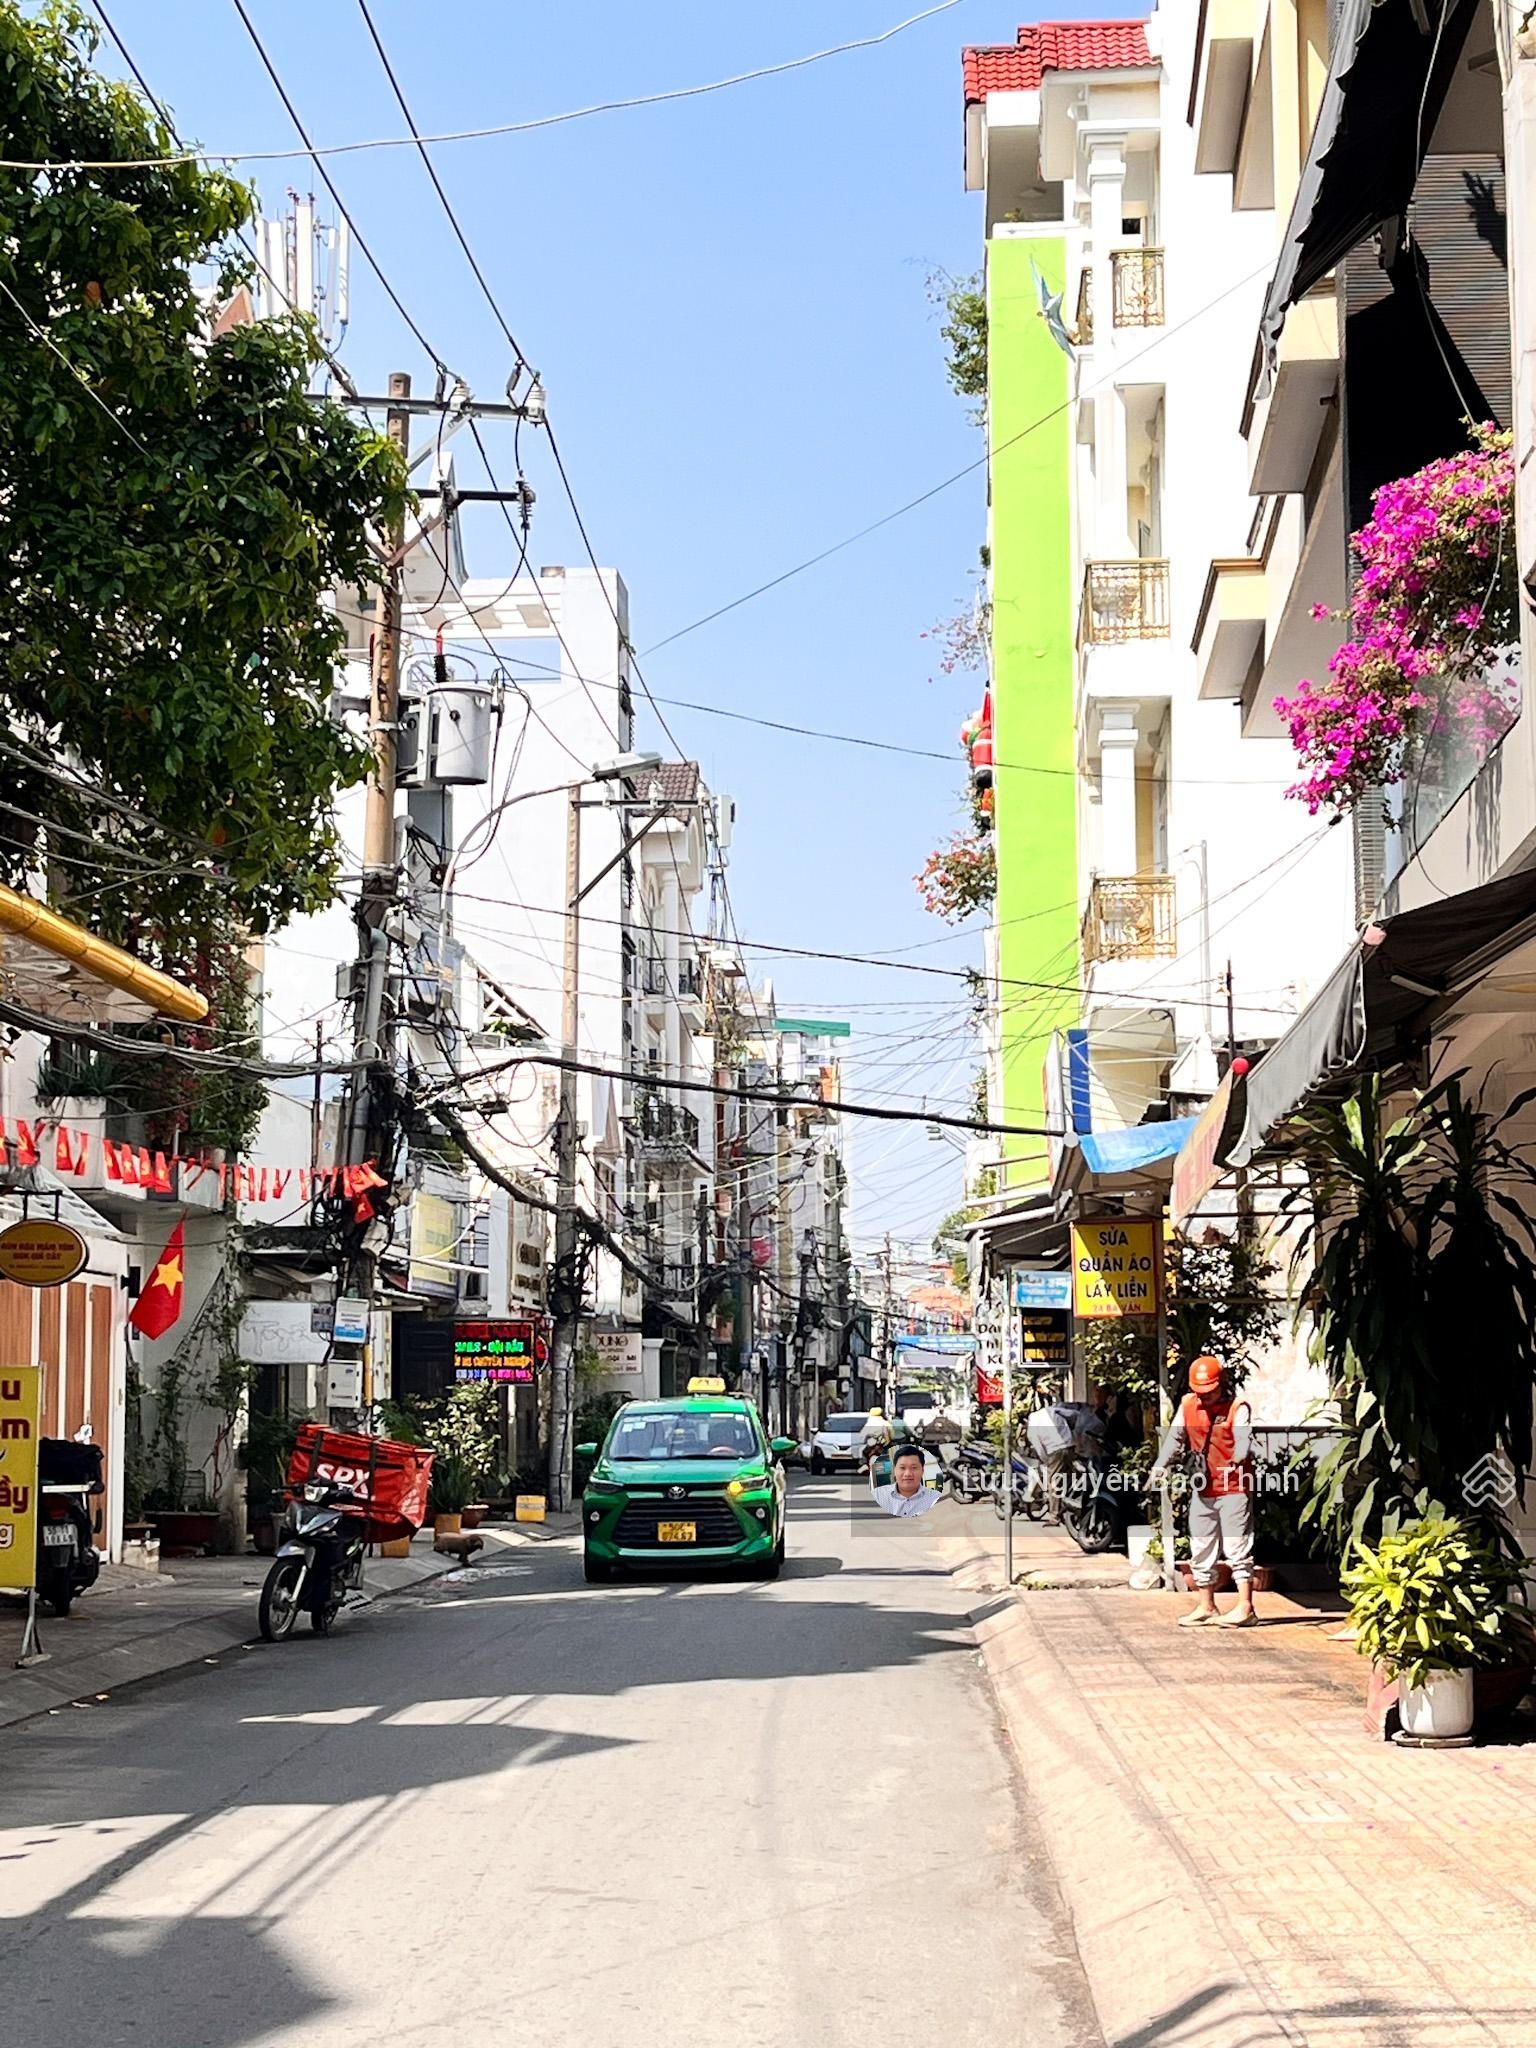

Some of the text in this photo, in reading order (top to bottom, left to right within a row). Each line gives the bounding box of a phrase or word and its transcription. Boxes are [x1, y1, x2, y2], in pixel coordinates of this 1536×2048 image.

[1099, 1225, 1128, 1246] SỬA
[1079, 1250, 1151, 1272] QUẦN ÁO
[1086, 1276, 1112, 1298] LẤY
[1117, 1275, 1147, 1298] LIỀN
